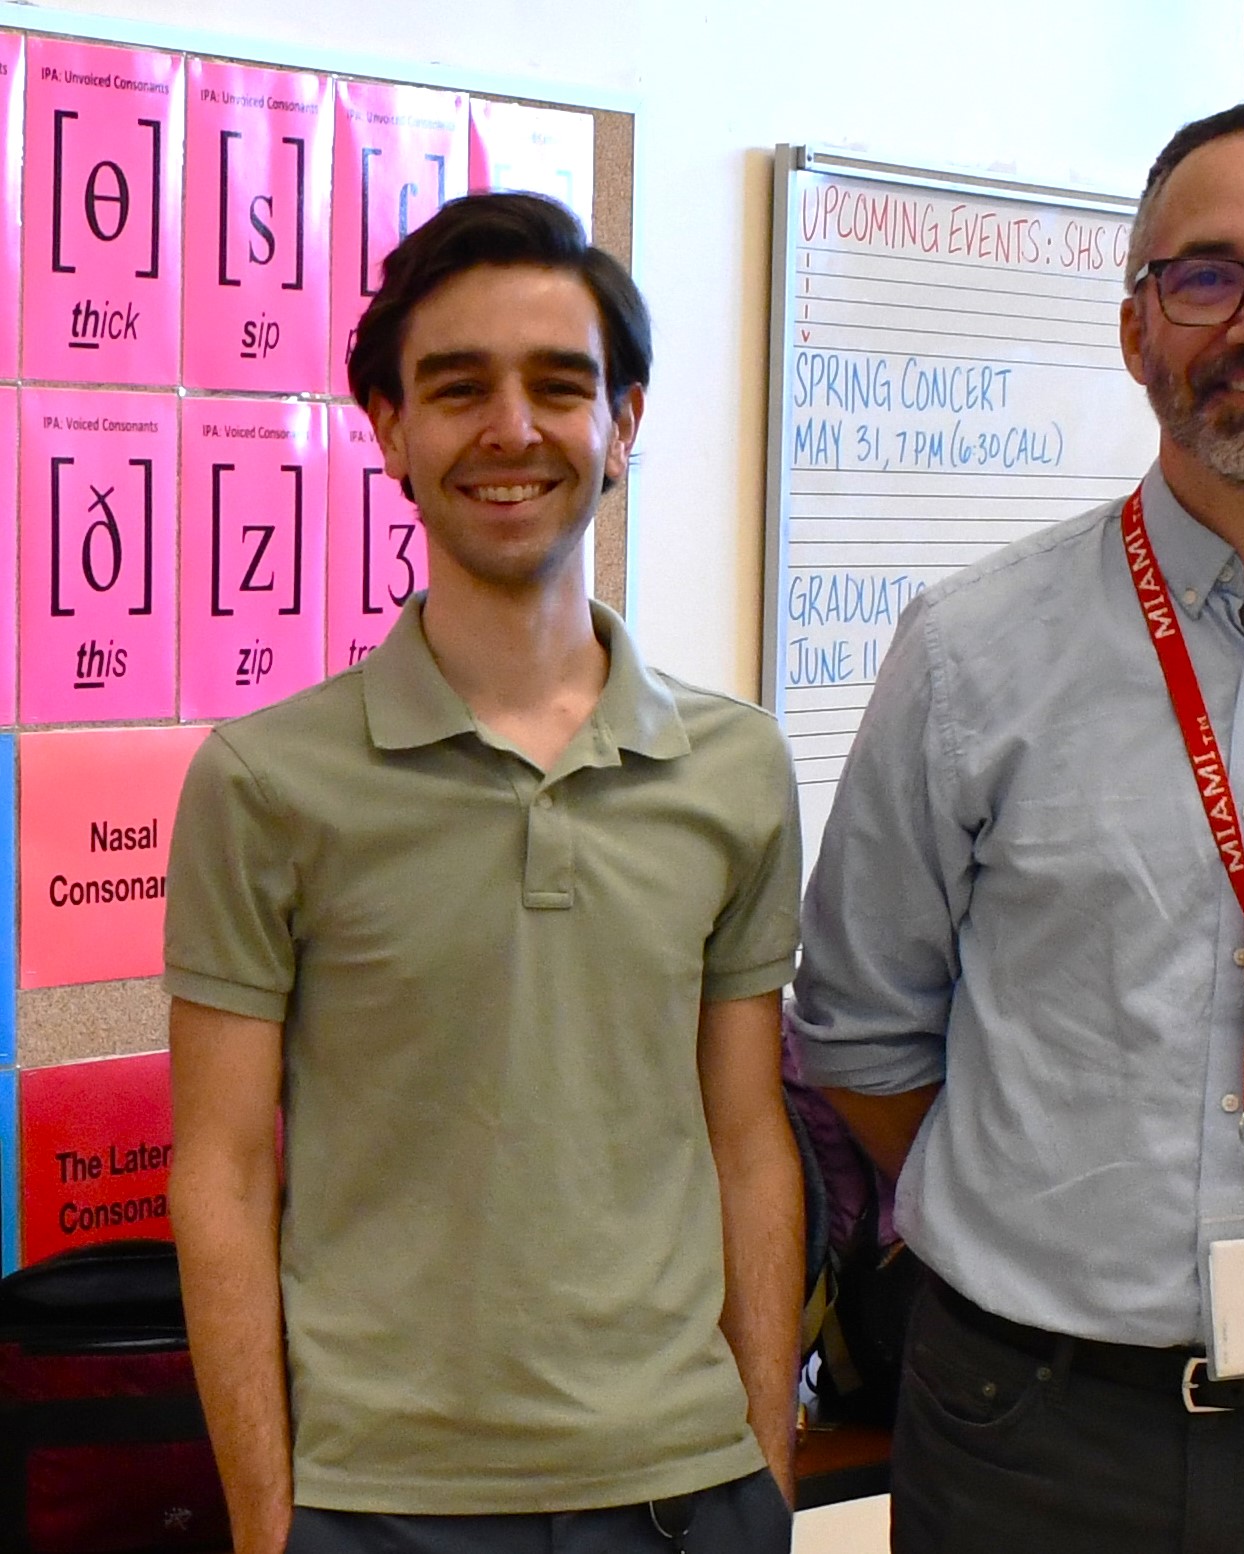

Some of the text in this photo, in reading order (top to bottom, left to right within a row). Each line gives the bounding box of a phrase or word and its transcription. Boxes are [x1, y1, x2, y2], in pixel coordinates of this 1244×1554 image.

[41, 67, 170, 96] IPA: Unvoiced Consonants
[201, 88, 220, 104] IPA:
[222, 91, 265, 109] Unvoiced
[802, 185, 940, 253] UPCOMING
[1060, 220, 1106, 271] SHS
[69, 299, 140, 349] thick
[240, 313, 280, 358] sip
[794, 351, 1012, 414] SPRING CONCERT
[43, 416, 158, 433] IPA: Voiced Consonants
[203, 424, 222, 438] IPA:
[225, 425, 256, 439] Voiced
[794, 416, 842, 470] MAY
[1125, 526, 1176, 640] MIAMI
[74, 639, 128, 689] this
[235, 638, 274, 685] zip
[790, 637, 853, 685] JUNE
[90, 818, 158, 852] Nasal
[1193, 751, 1244, 873] MIAMI
[55, 1150, 103, 1183] The
